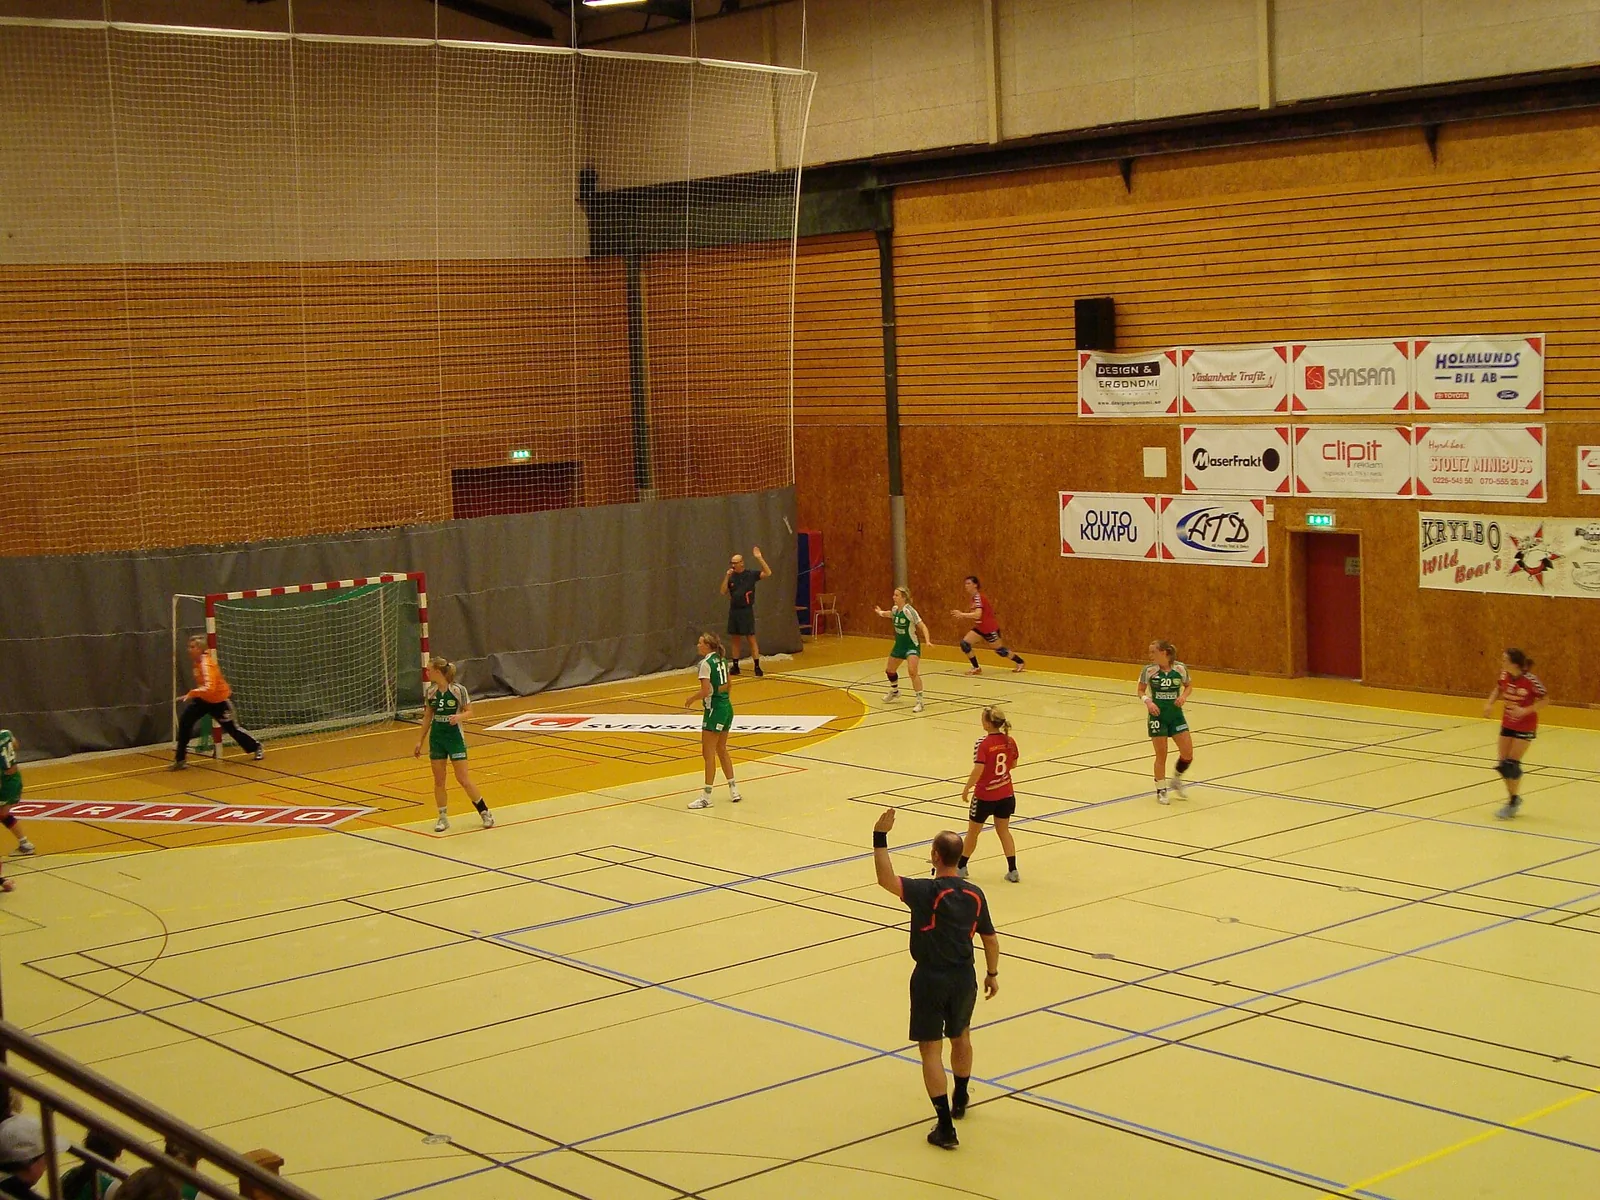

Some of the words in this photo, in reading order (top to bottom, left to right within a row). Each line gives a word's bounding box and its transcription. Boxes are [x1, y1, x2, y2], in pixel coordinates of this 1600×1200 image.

[1435, 352, 1521, 369] HOLMLUNDS
[1098, 366, 1139, 375] DESIGN
[1143, 365, 1153, 375] &
[1328, 366, 1396, 387] SYNSAM
[1455, 373, 1475, 383] BIL
[1481, 372, 1498, 383] AB
[1099, 378, 1158, 389] ERGONOMI
[1323, 439, 1383, 468] clipit
[1430, 456, 1470, 472] STOLTZ
[1472, 456, 1533, 473] MINIBUSS
[1085, 509, 1133, 527] OUTO
[1187, 511, 1250, 543] ATD
[1080, 524, 1138, 543] KUMPU
[1421, 517, 1502, 554] KRYLBO
[1422, 548, 1459, 576] Wild
[716, 660, 728, 685] 11
[1160, 678, 1172, 687] 20
[438, 698, 445, 708] 5
[732, 724, 806, 732] SPEL
[1149, 720, 1160, 729] 20
[994, 752, 1007, 776] 8
[8, 803, 336, 822] CRAMO
